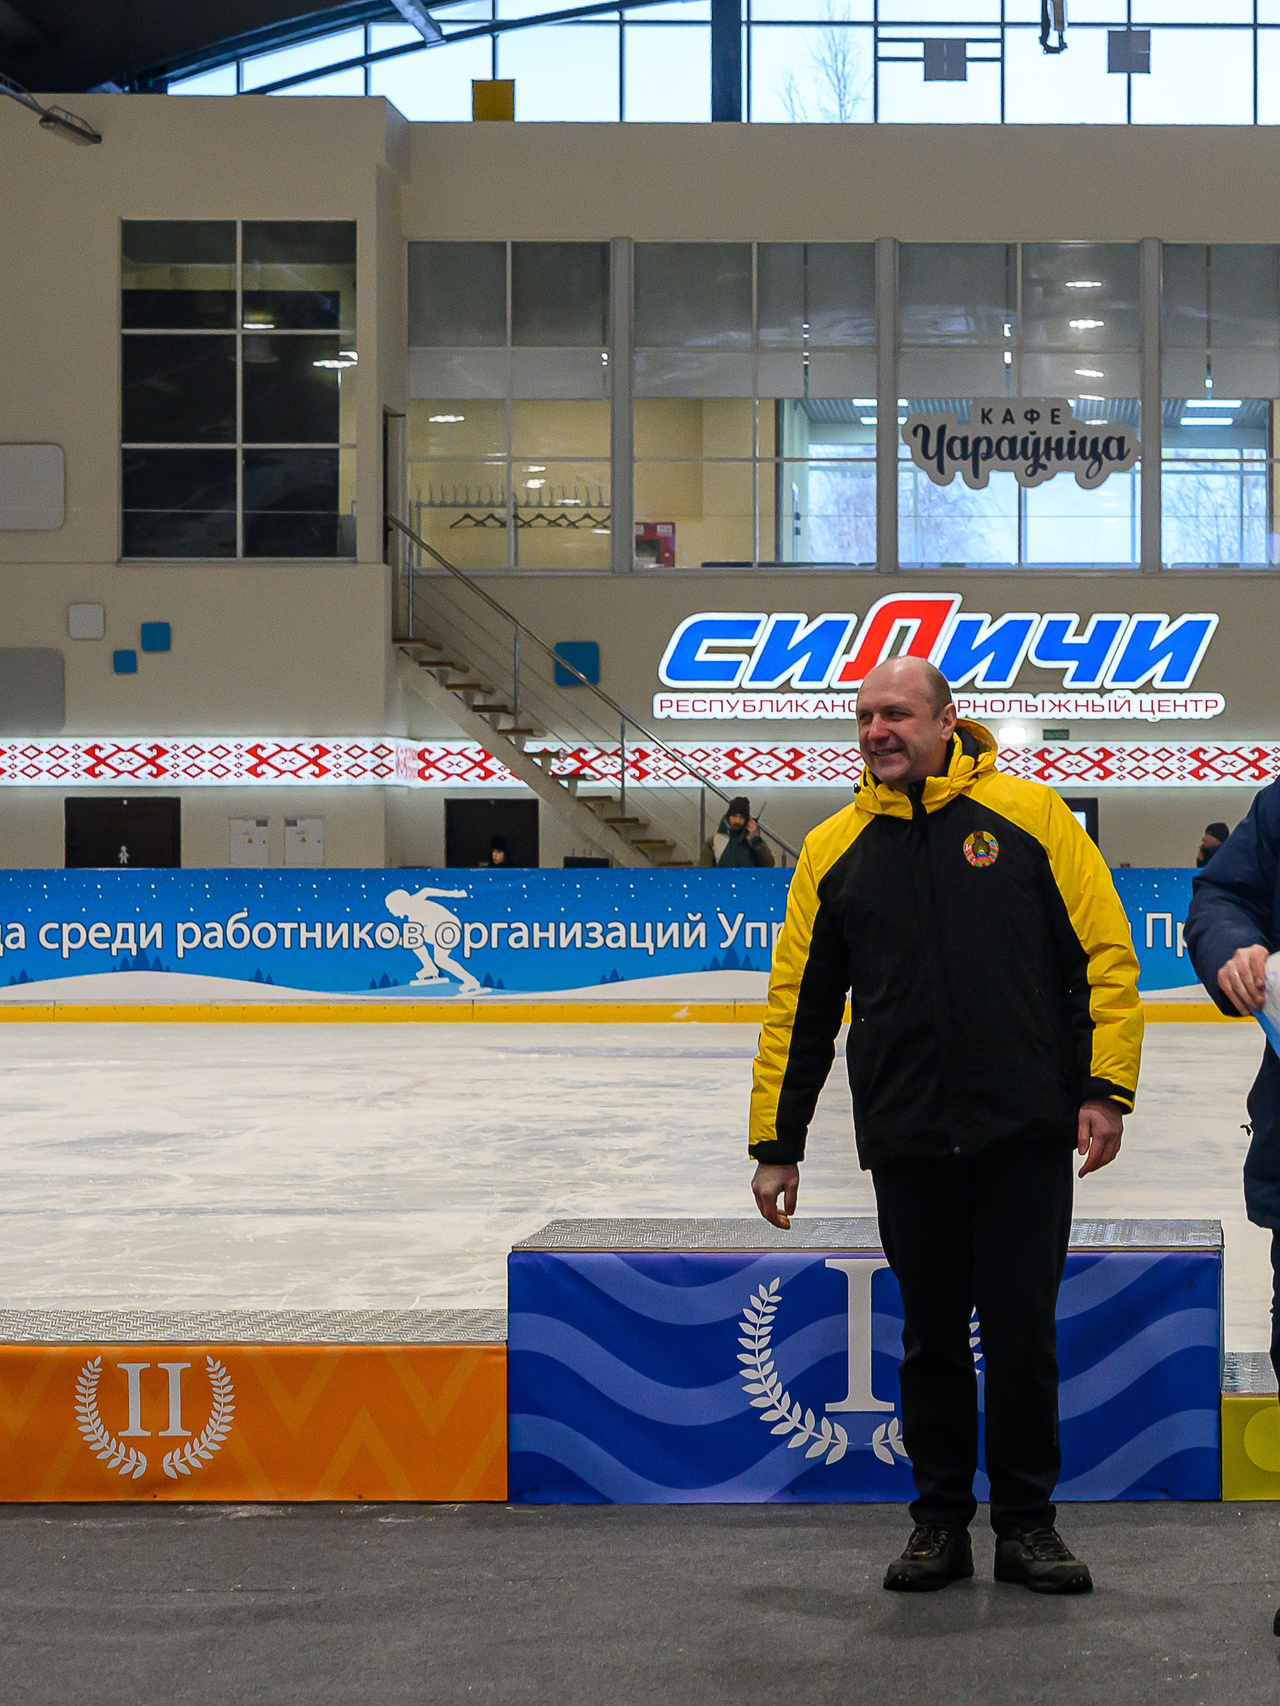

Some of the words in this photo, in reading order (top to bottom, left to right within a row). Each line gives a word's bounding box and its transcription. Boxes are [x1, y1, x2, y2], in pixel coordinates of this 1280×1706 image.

[980, 407, 1062, 425] КАФЕ
[911, 422, 1131, 480] Чараўніца
[1139, 699, 1219, 717] ЦЕНТР
[0, 922, 26, 957] а
[38, 922, 163, 959] среди
[176, 910, 425, 959] работников
[434, 912, 707, 959] организаций
[117, 1362, 192, 1437] II
